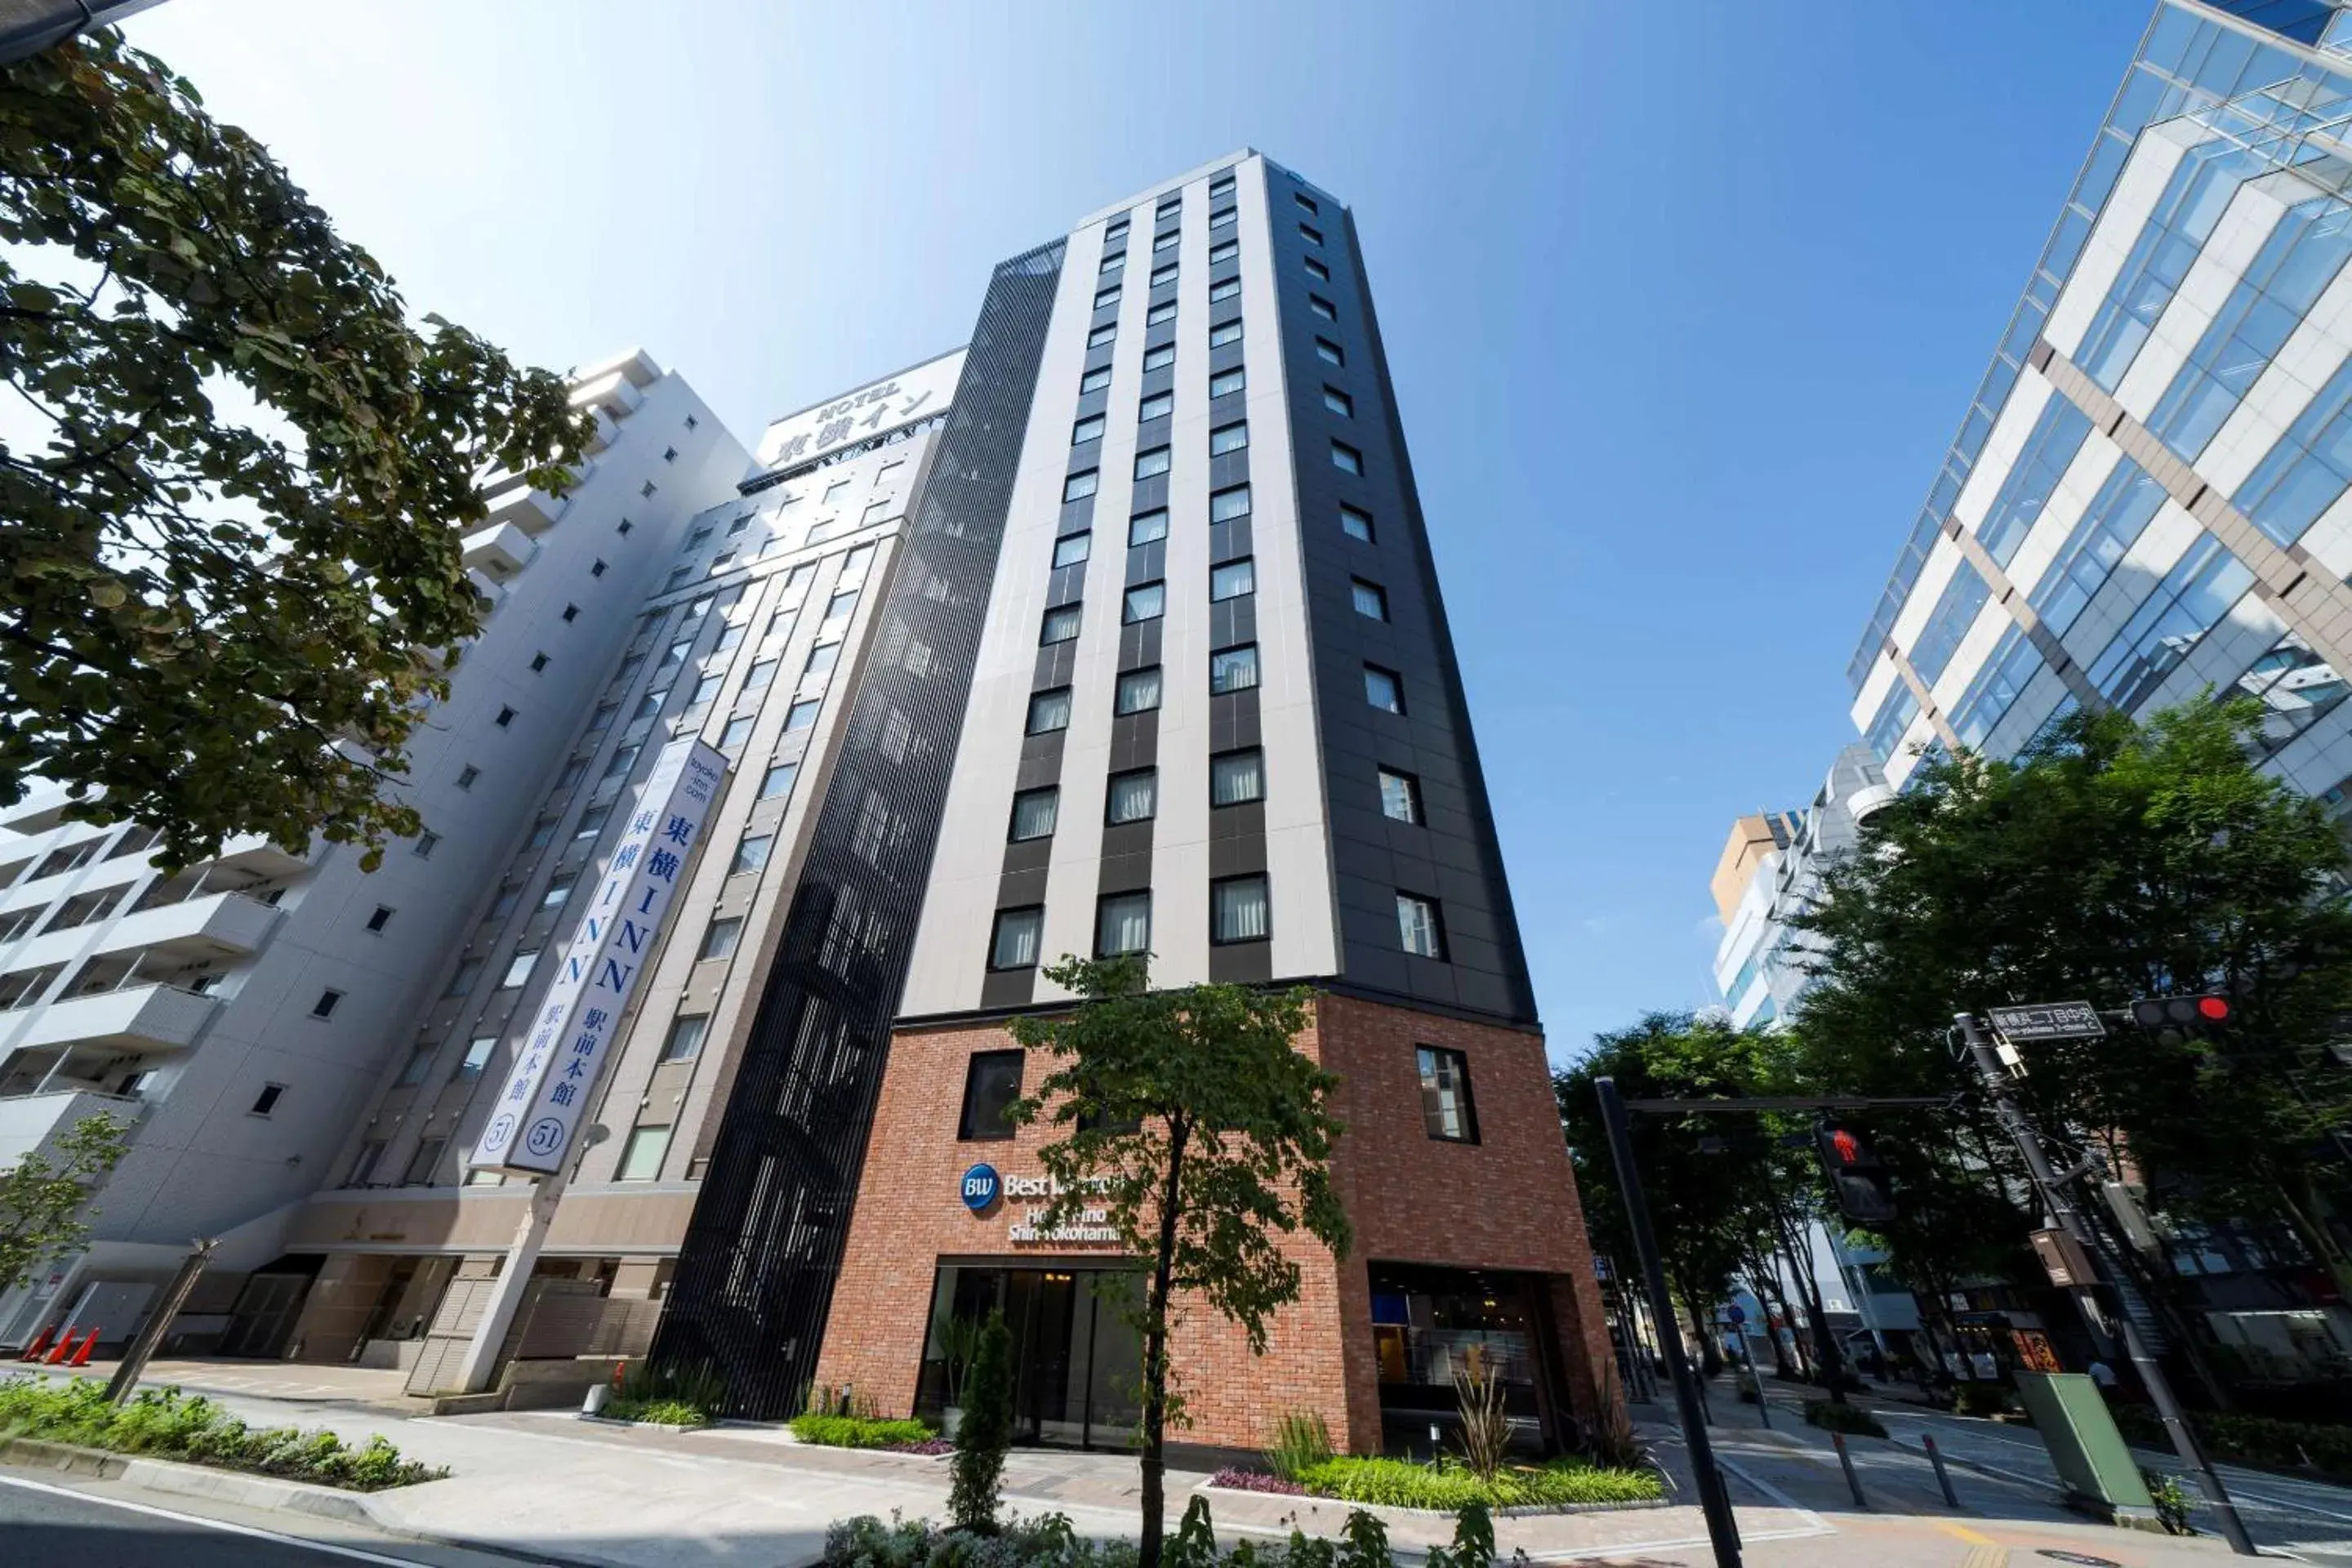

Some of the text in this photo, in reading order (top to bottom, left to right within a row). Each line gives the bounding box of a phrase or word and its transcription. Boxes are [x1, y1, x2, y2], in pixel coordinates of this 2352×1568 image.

[815, 381, 901, 424] HOTEL
[557, 809, 657, 985] 東横INN
[596, 813, 694, 994] 東横INN
[550, 1006, 608, 1107] 駅前本館
[964, 1178, 994, 1196] BW
[1003, 1175, 1048, 1196] Best
